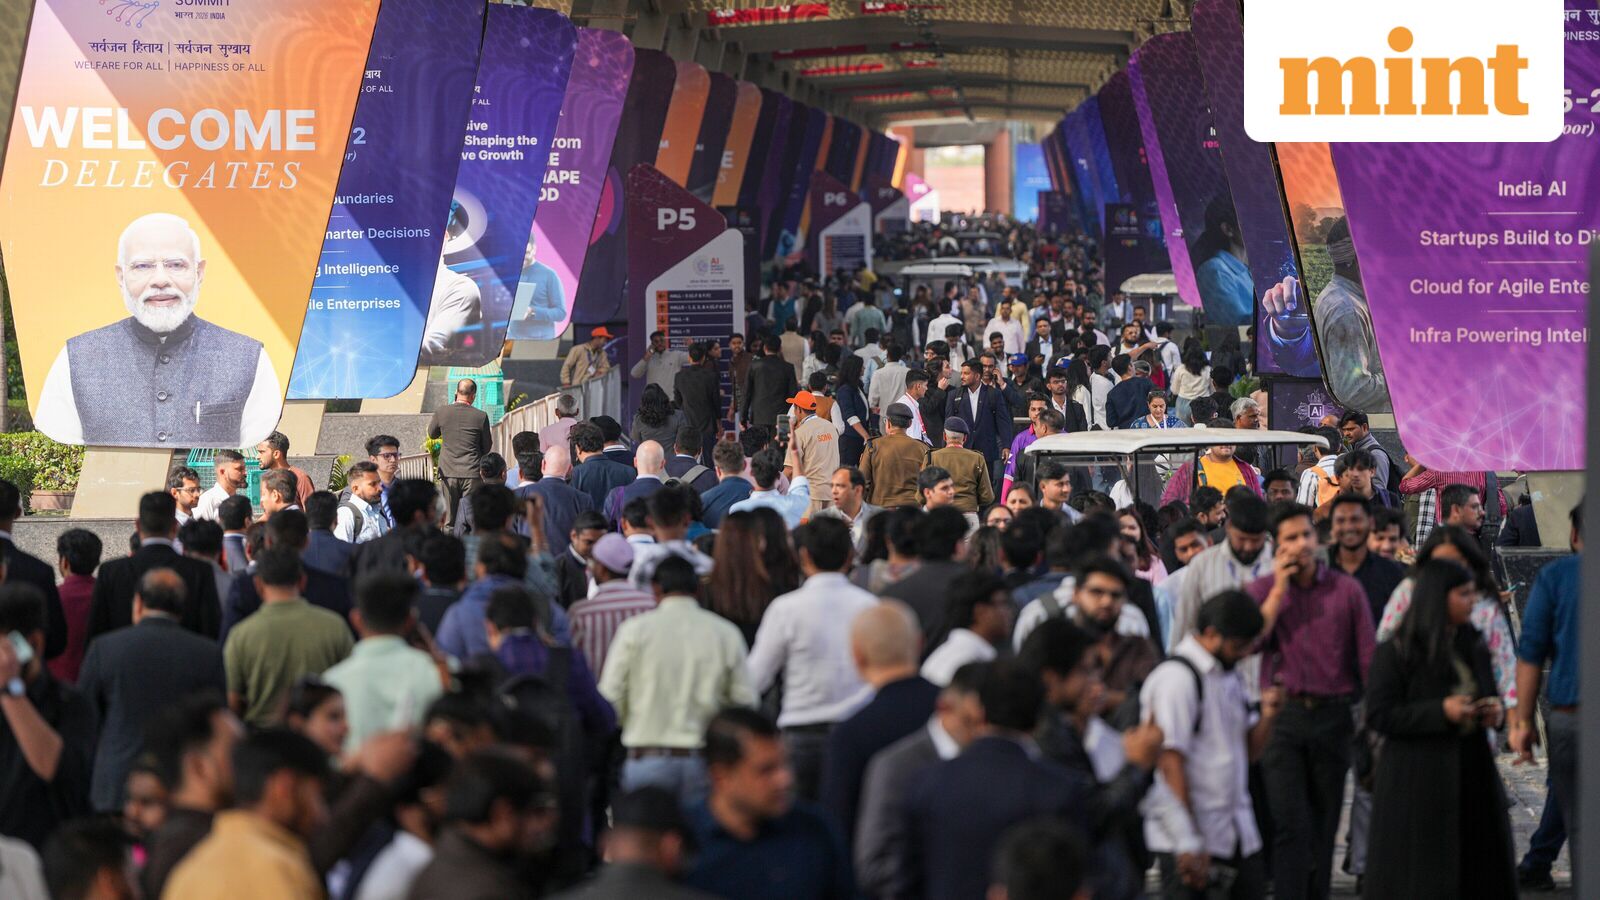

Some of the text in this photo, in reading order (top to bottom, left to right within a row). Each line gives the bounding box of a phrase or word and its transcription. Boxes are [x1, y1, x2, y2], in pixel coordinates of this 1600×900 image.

[210, 12, 225, 20] INDIA
[88, 38, 252, 58] सर्वजन हिताय सर्वजन सुखाय
[74, 61, 266, 72] WELFARE FOR ALL HAPPINESS OF ALL
[365, 85, 377, 93] OF
[378, 85, 394, 93] ALL
[21, 106, 316, 151] WELCOME
[352, 127, 367, 145] 2
[464, 134, 538, 149] Shaping the
[479, 149, 524, 161] Growth
[39, 158, 302, 189] DELEGATES
[1498, 180, 1567, 197] India AI
[824, 192, 847, 206] P6
[657, 207, 697, 231] P5
[368, 226, 431, 239] Decisions
[1420, 230, 1499, 249] Startups
[1504, 229, 1550, 246] Build
[1554, 231, 1573, 246] to
[324, 262, 400, 278] Intelligence
[1410, 278, 1591, 298] Cloud for Agile Ente
[327, 297, 401, 312] Enterprises
[1410, 327, 1452, 343] Infra
[1456, 327, 1542, 347] Powering
[1311, 406, 1322, 417] Ai
